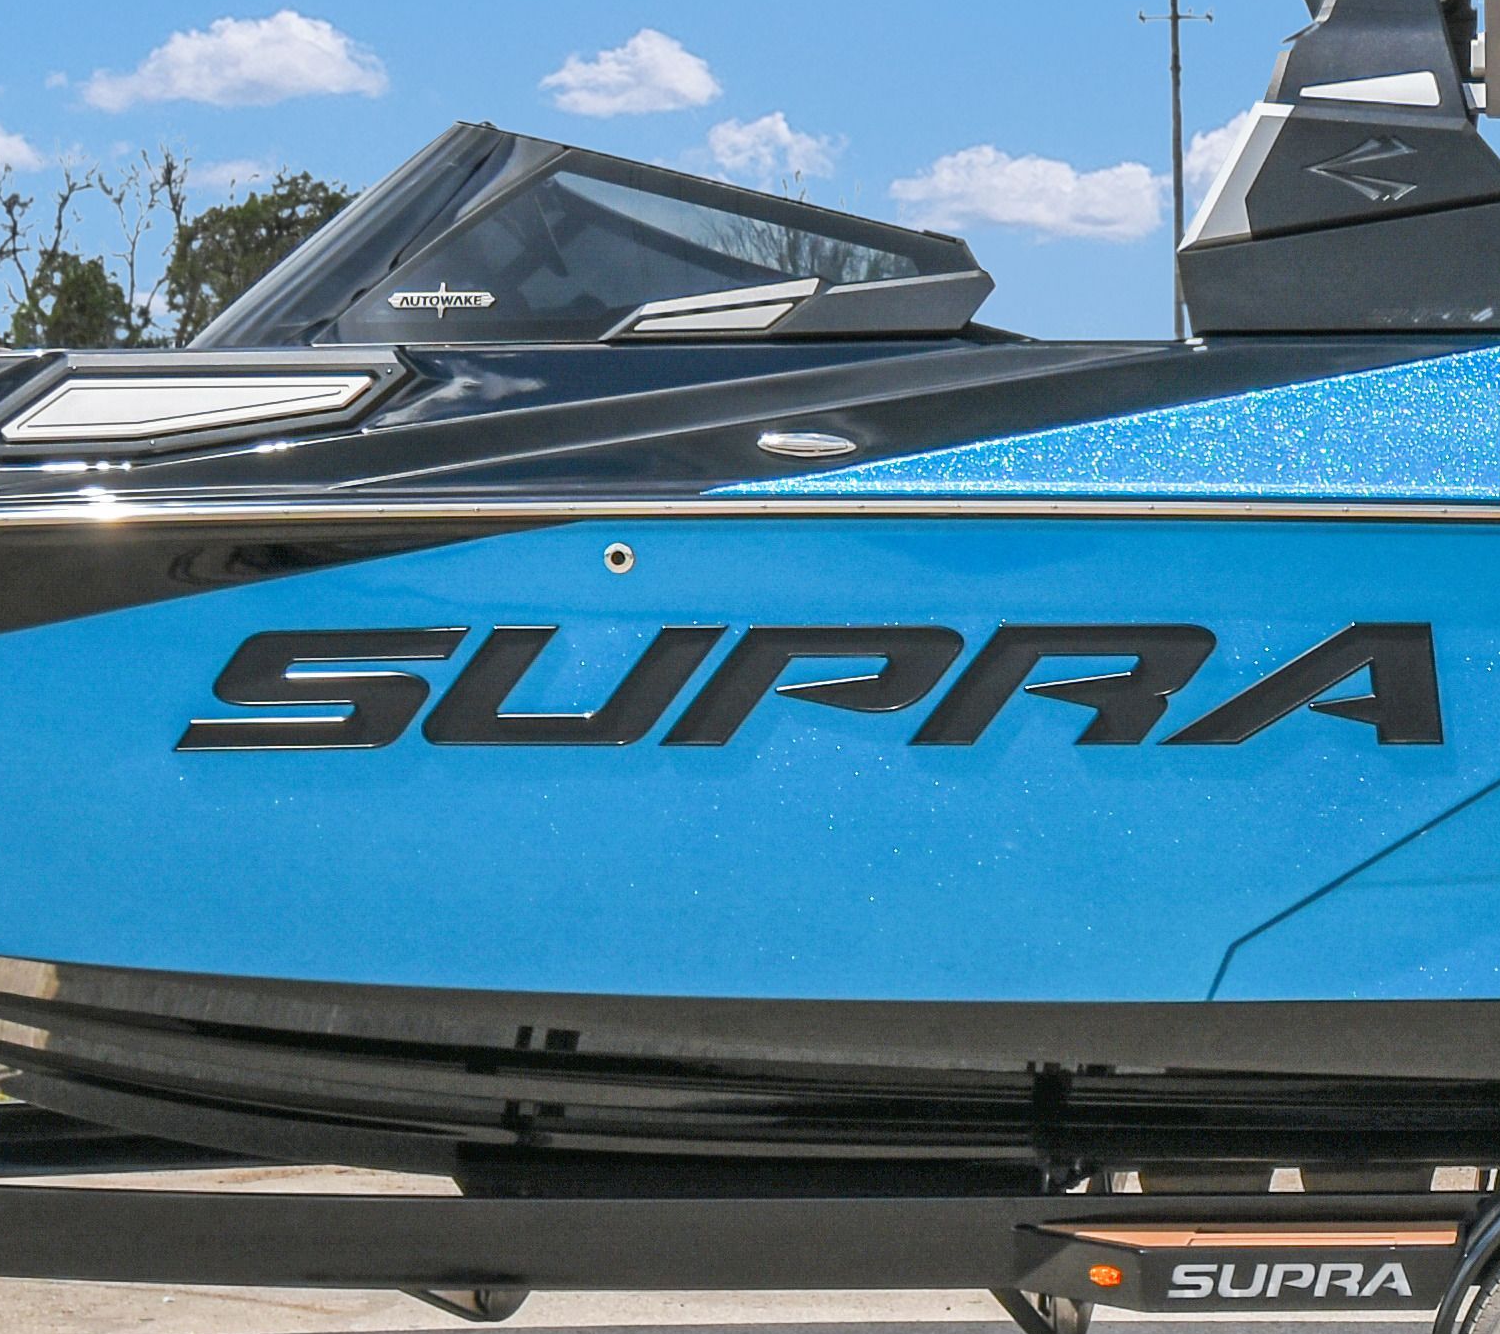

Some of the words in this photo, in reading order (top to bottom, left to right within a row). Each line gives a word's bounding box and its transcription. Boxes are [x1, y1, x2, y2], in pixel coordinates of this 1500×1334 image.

[400, 295, 482, 307] AUTOWAKE
[173, 622, 1445, 753] SUPRA
[1167, 1262, 1413, 1299] SUPRA
